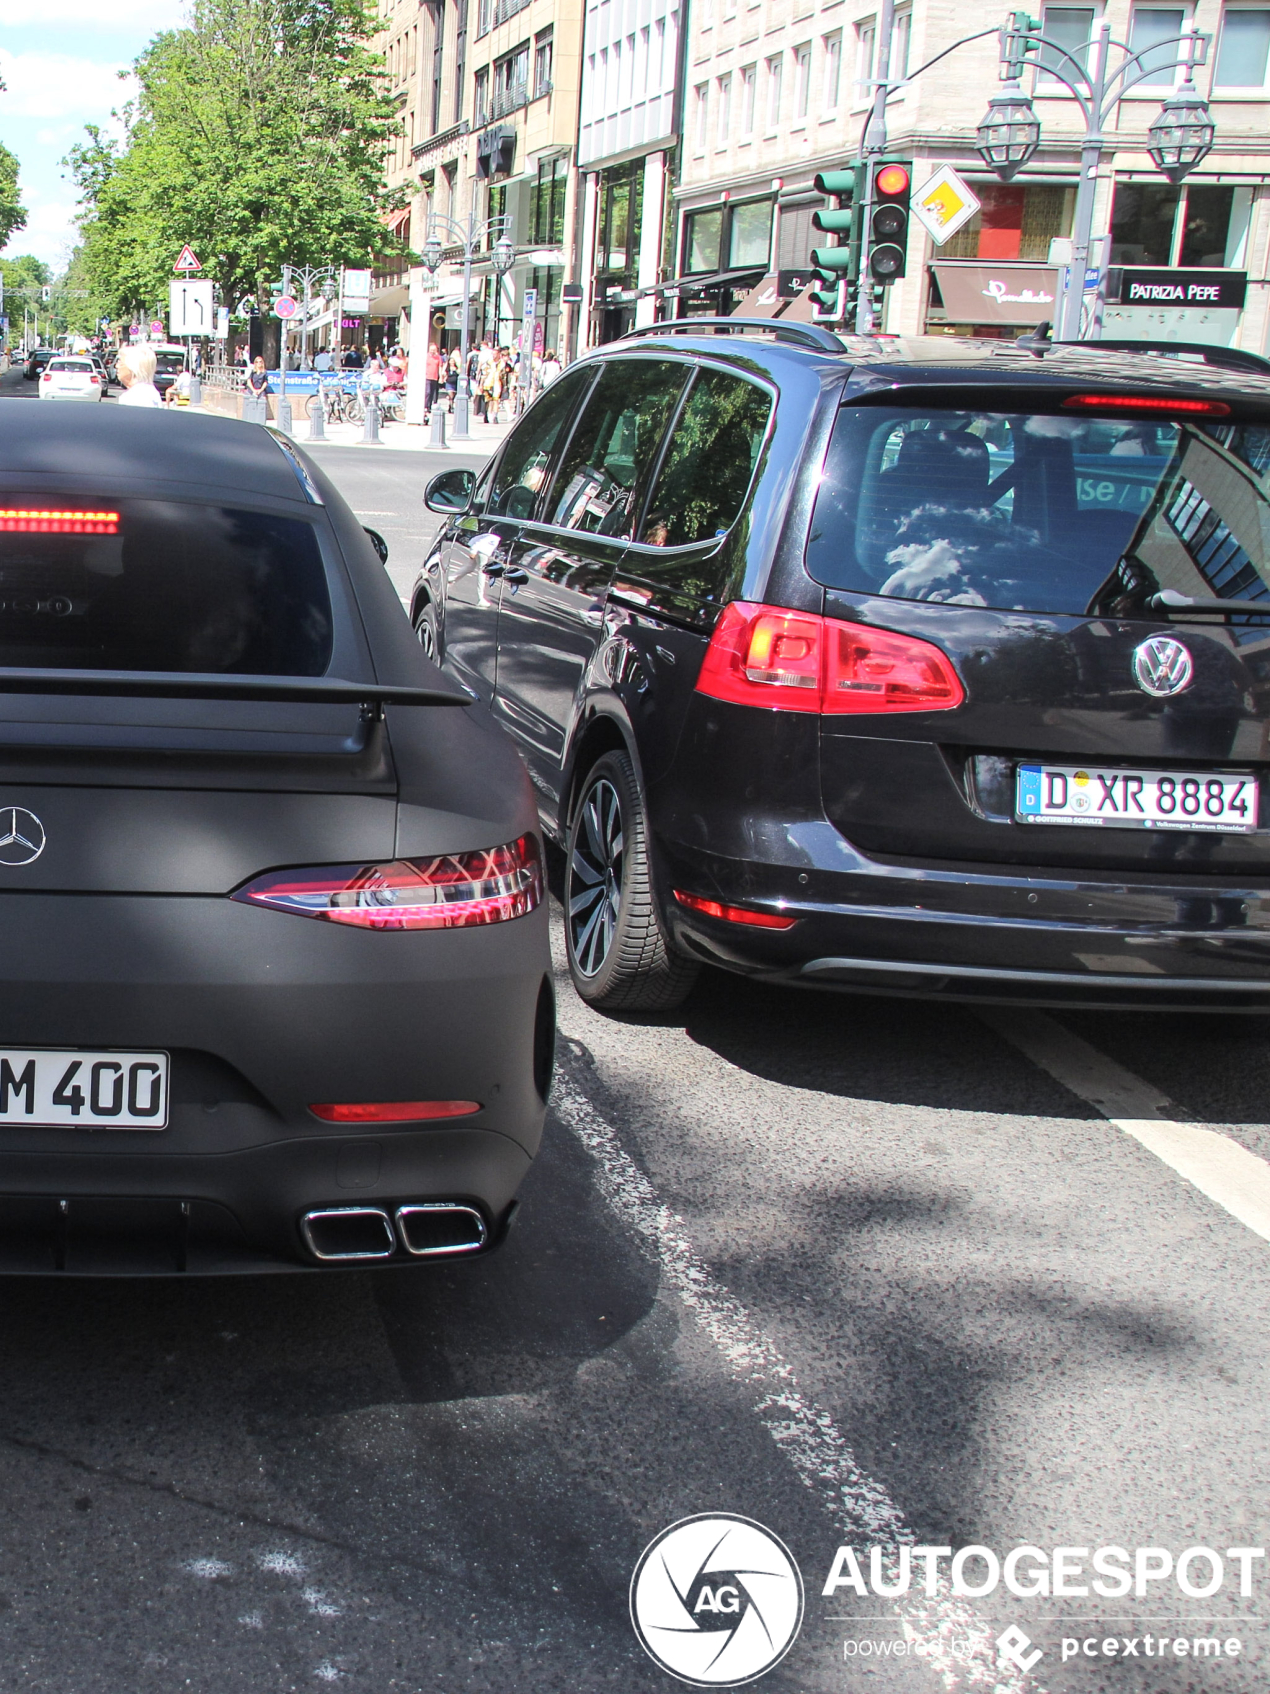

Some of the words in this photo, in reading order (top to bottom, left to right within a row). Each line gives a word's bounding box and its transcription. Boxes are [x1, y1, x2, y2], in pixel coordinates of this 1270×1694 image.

[1130, 283, 1185, 299] PATRIZIA
[1188, 284, 1220, 300] PEPE
[268, 375, 318, 385] Stenstraße
[1026, 794, 1035, 805] D
[1044, 771, 1068, 810] D
[1096, 773, 1145, 813] XR
[1155, 776, 1248, 818] 8884
[1156, 821, 1190, 829] Volkswagen
[1217, 823, 1246, 831] Düsseldorf
[52, 1060, 161, 1117] 400
